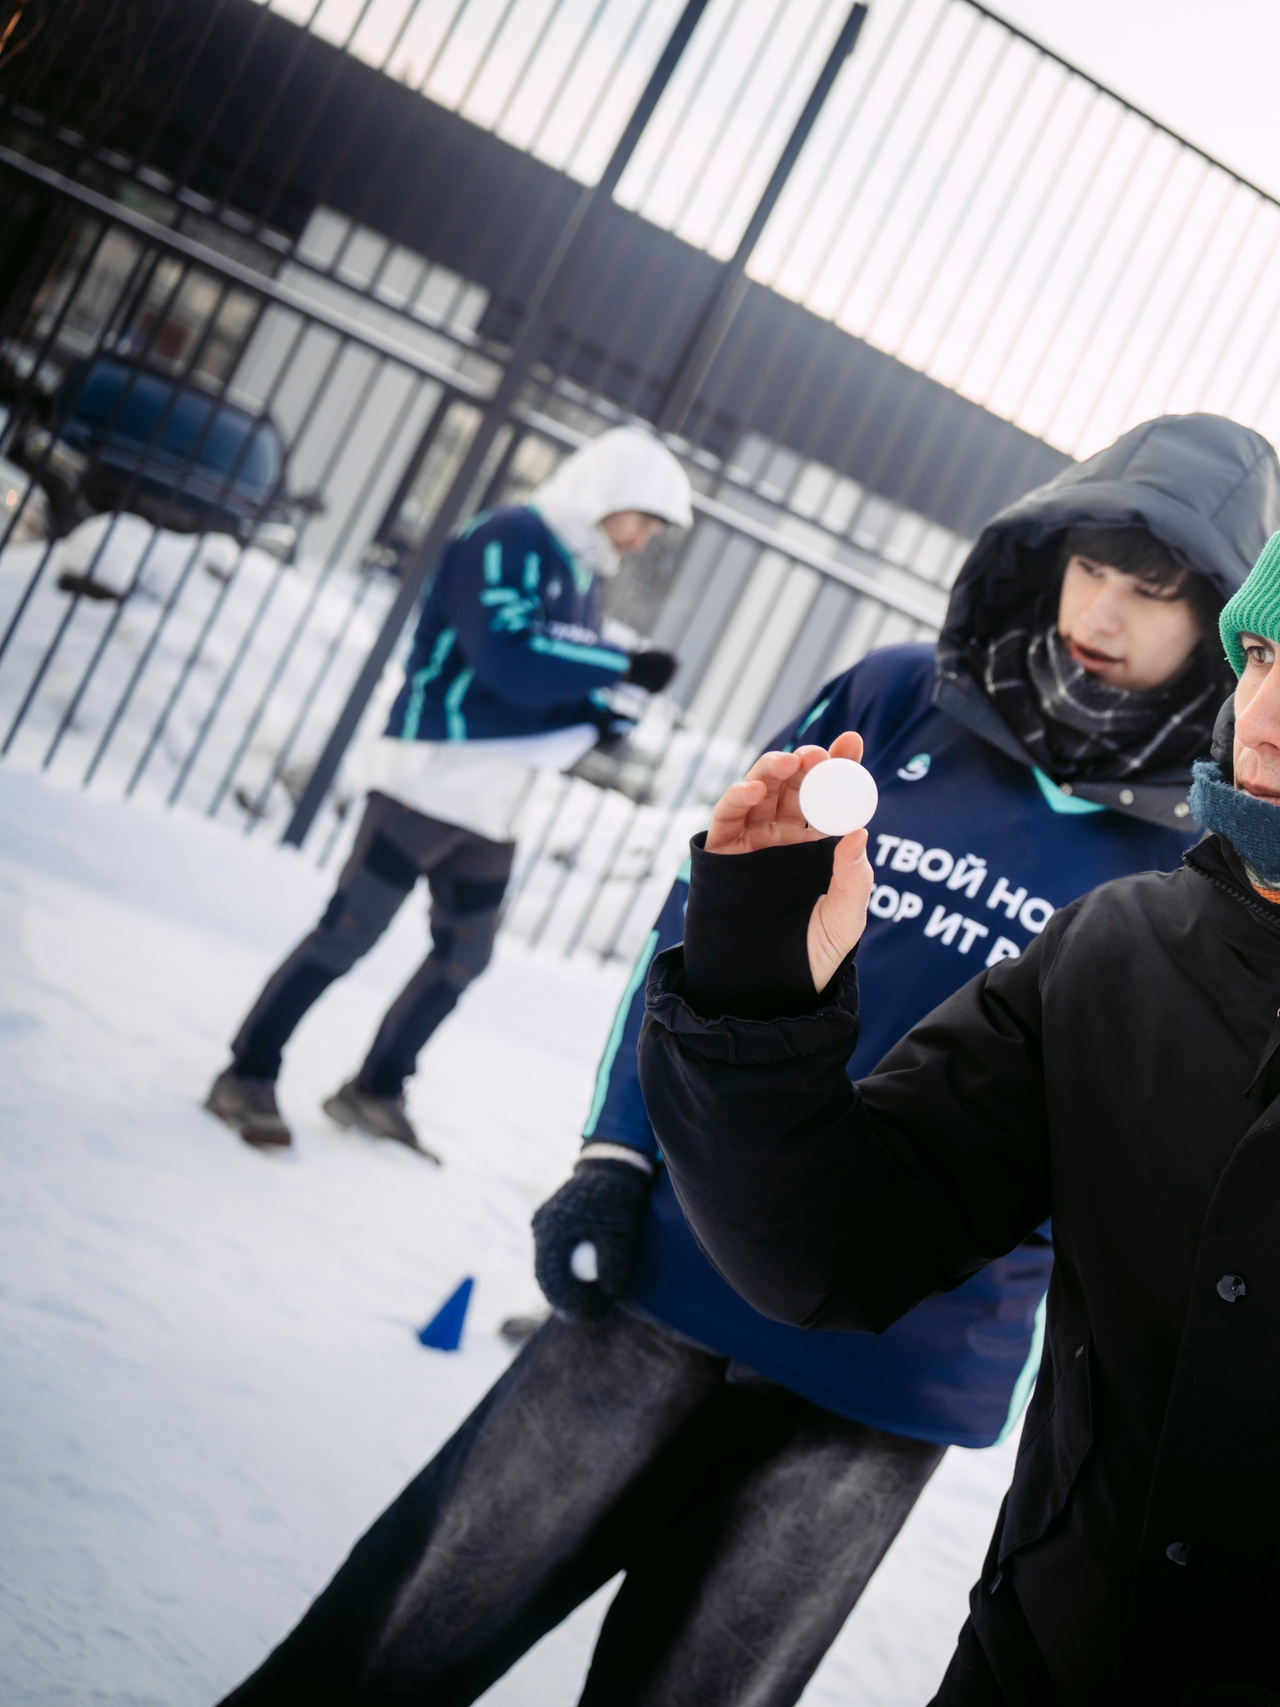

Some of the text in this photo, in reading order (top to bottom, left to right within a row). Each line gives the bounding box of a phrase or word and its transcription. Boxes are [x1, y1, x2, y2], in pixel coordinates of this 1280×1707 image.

[875, 833, 988, 899] ТВОЙ
[869, 883, 924, 922] ОР
[923, 904, 989, 954] ИТ
